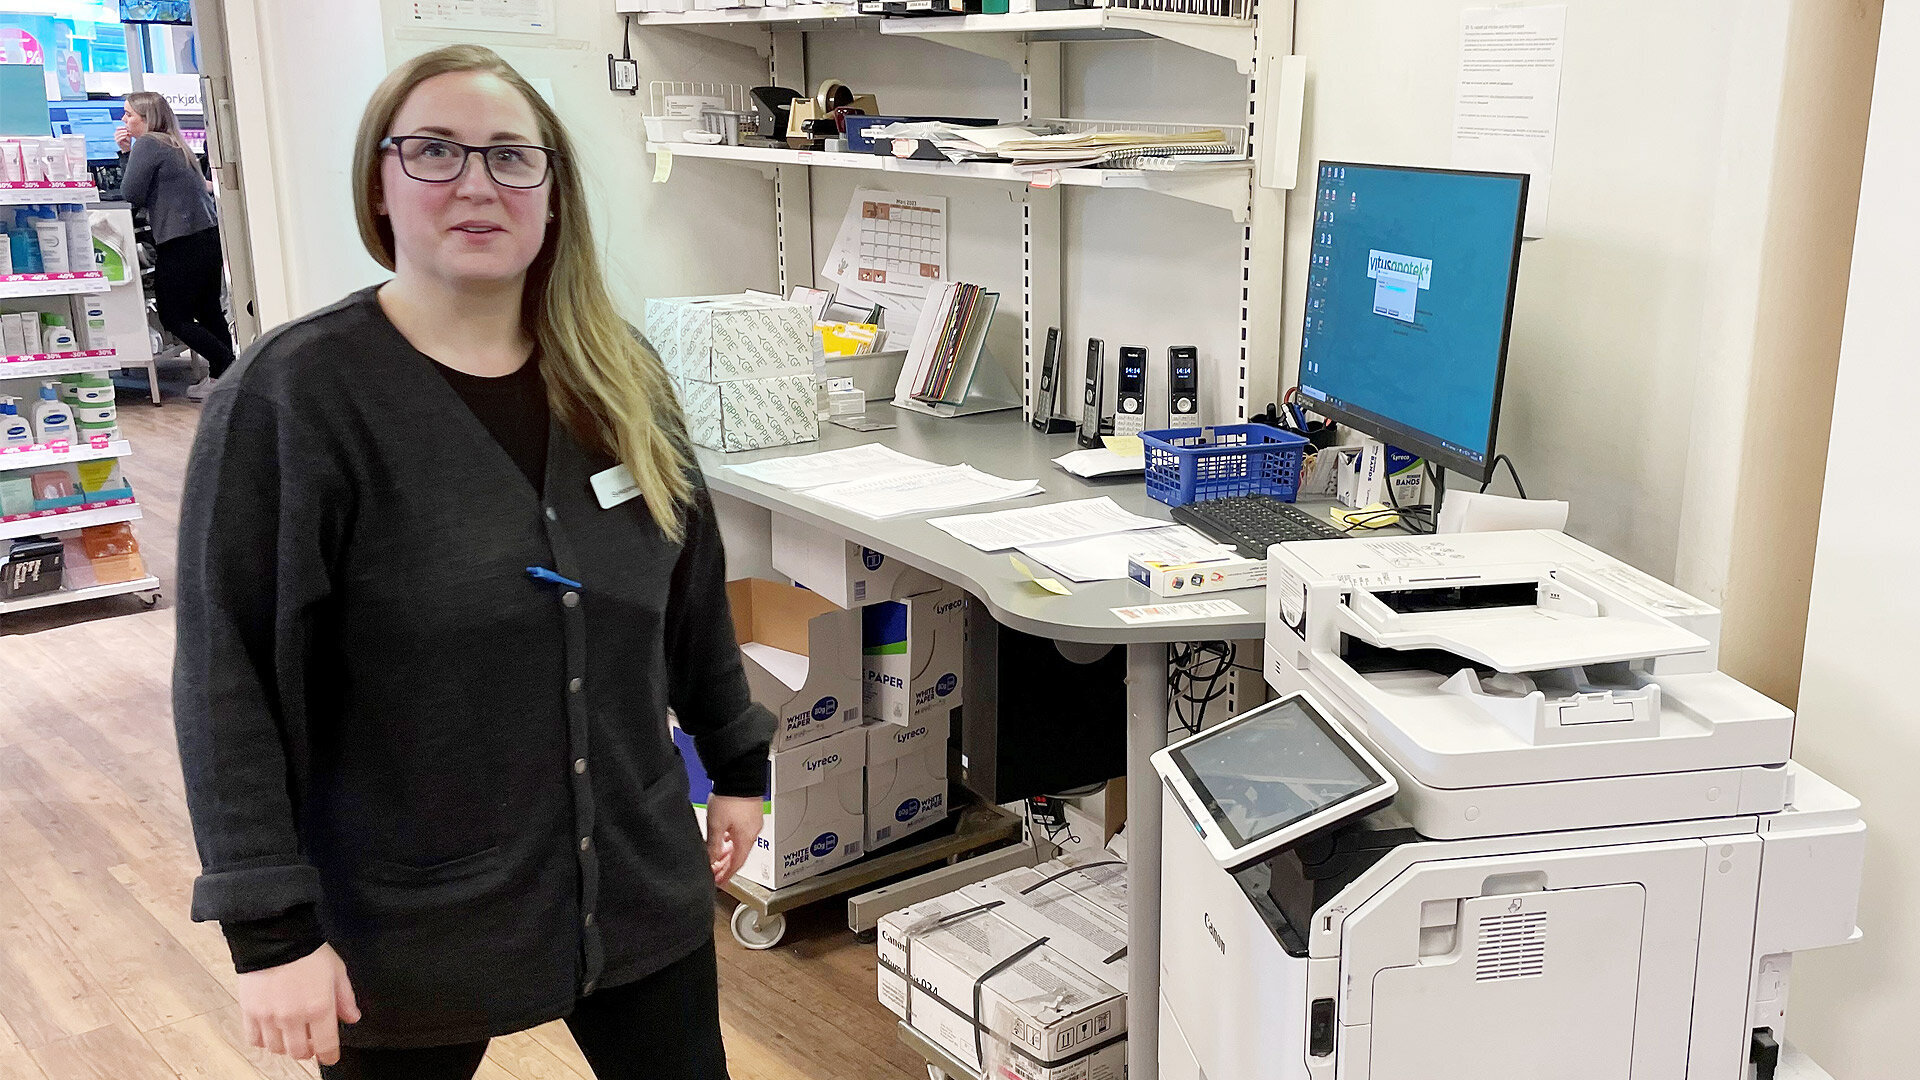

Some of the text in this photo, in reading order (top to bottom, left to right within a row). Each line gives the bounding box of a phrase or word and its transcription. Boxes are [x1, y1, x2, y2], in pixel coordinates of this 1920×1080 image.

[163, 93, 203, 106] orkjøl
[936, 599, 962, 615] Lyreco
[868, 670, 904, 690] PAPER
[786, 710, 811, 724] WHITE
[787, 717, 811, 732] PAPER
[897, 726, 926, 743] Lyreco
[807, 754, 839, 771] Lyreco
[783, 846, 810, 861] WHITE
[784, 854, 810, 869] PAPER
[1204, 912, 1226, 955] Canon
